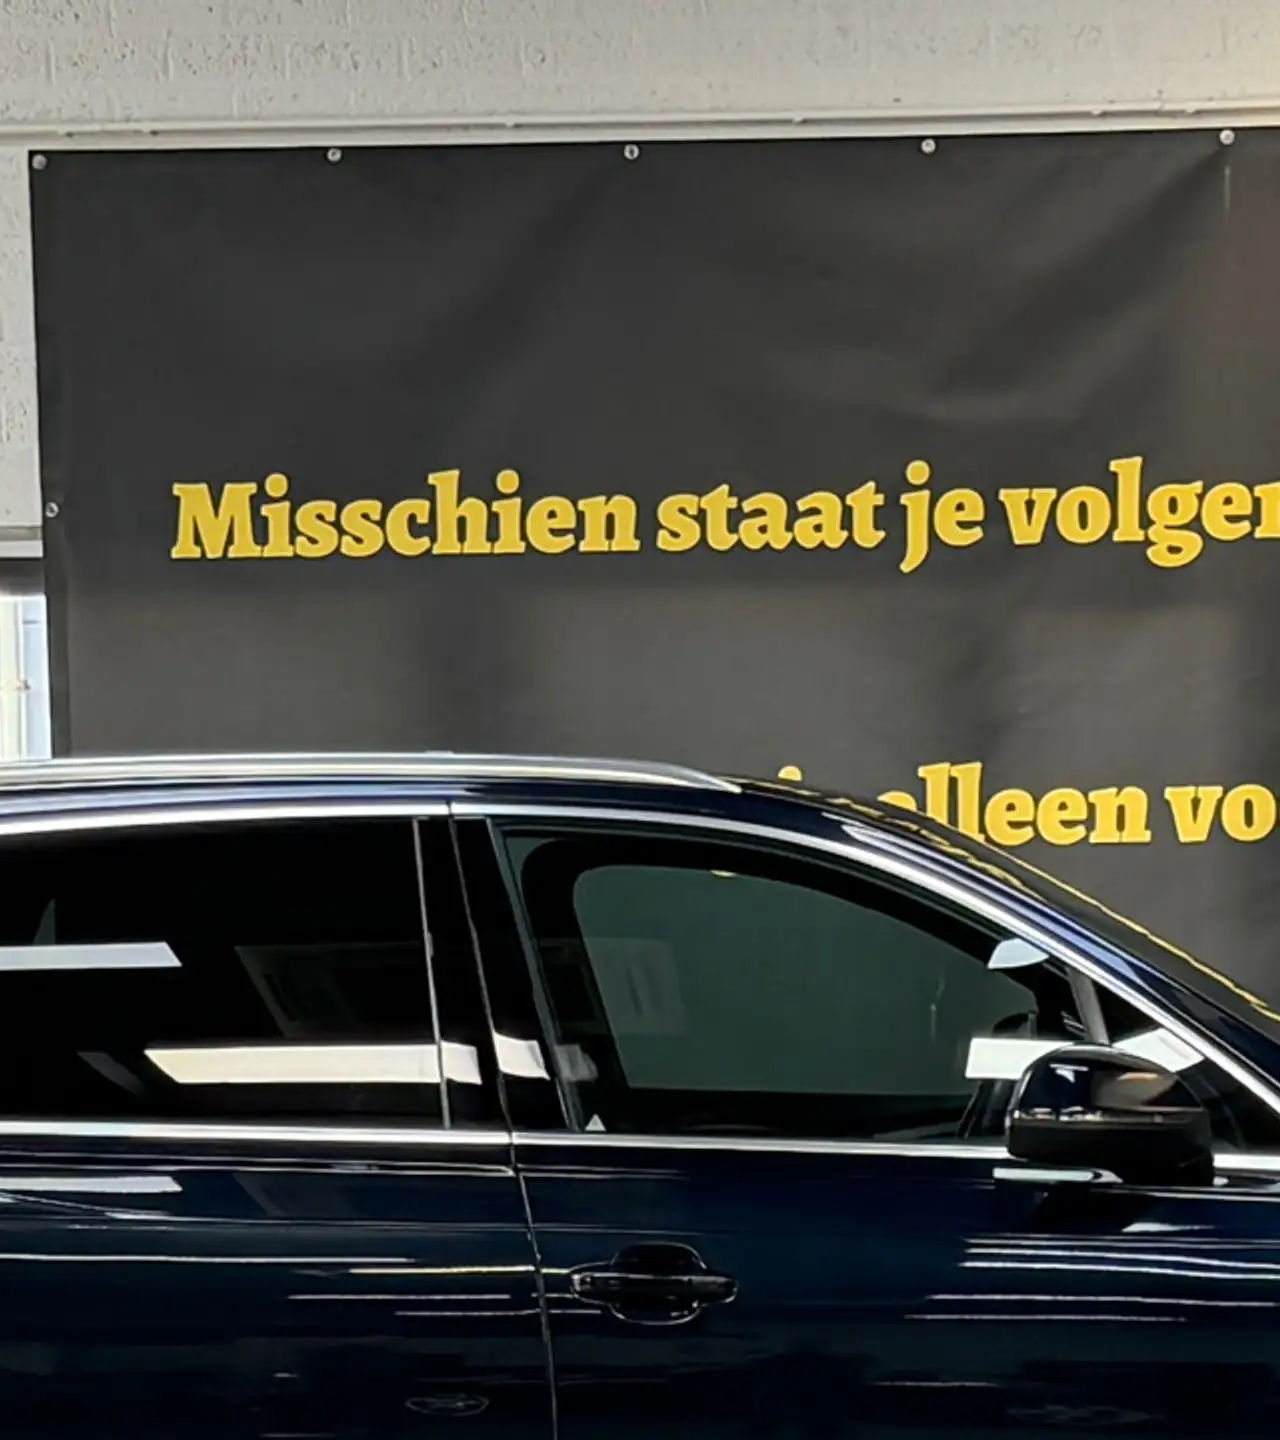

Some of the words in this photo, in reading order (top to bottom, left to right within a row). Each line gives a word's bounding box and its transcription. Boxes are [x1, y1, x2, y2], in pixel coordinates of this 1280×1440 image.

[170, 469, 641, 560] Misschien
[655, 482, 885, 552] staat
[900, 461, 985, 574] je
